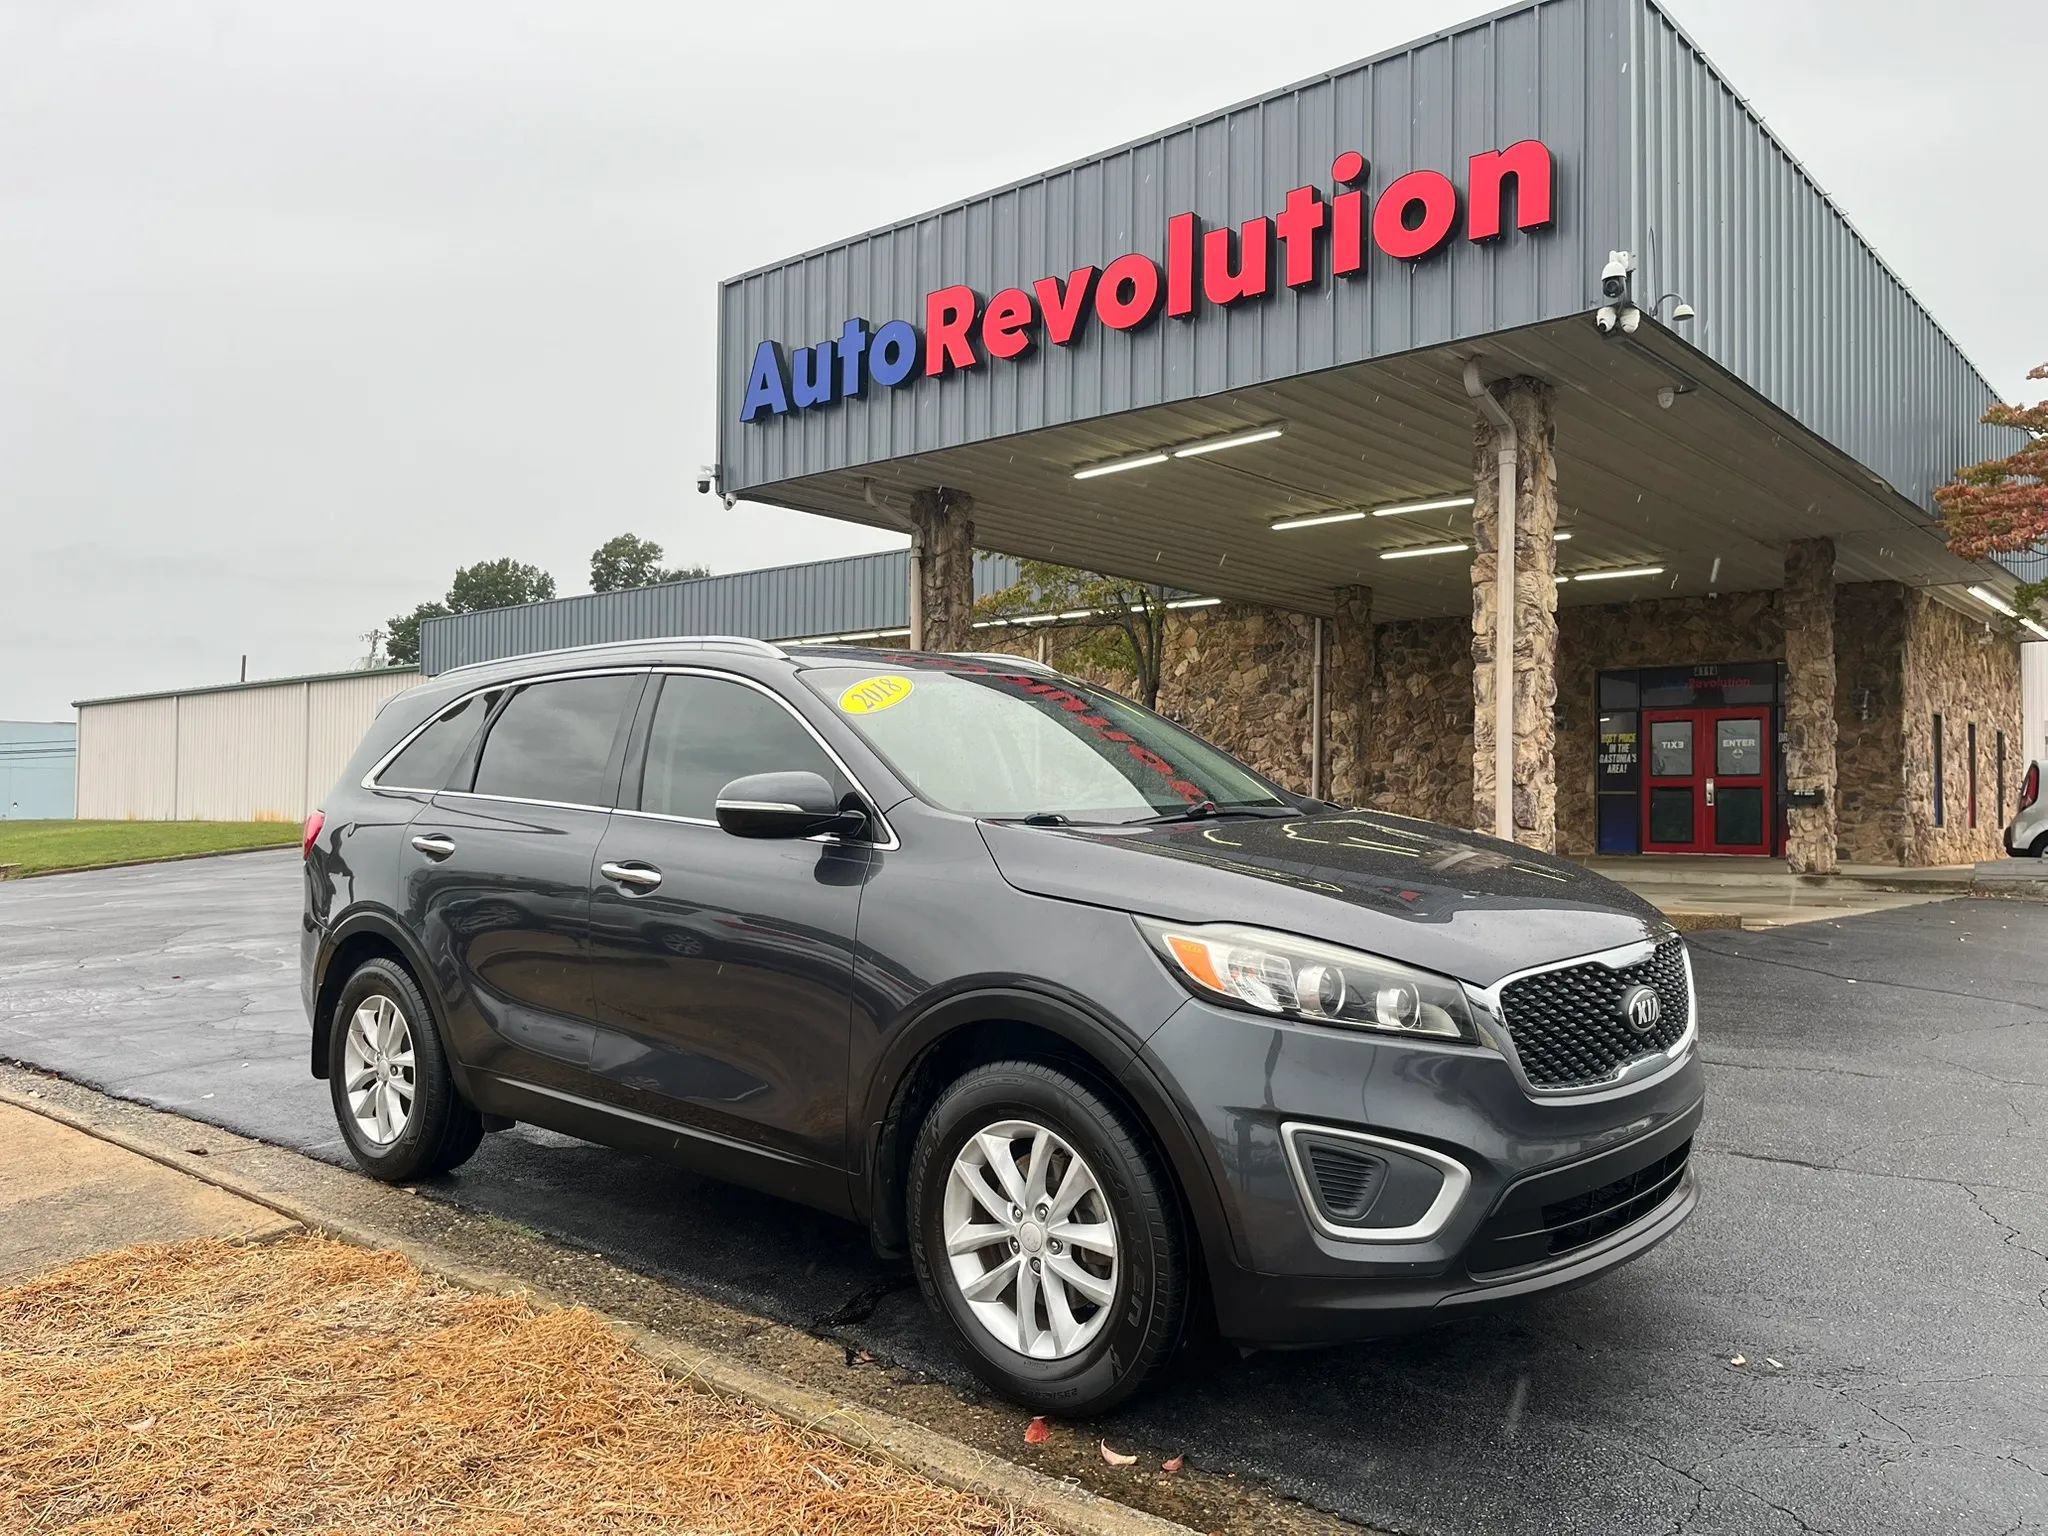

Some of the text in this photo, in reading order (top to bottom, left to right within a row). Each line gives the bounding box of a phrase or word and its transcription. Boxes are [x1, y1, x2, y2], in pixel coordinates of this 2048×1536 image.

[851, 678, 902, 709] 2018
[1722, 738, 1756, 747] ENTER
[1617, 743, 1630, 753] THE
